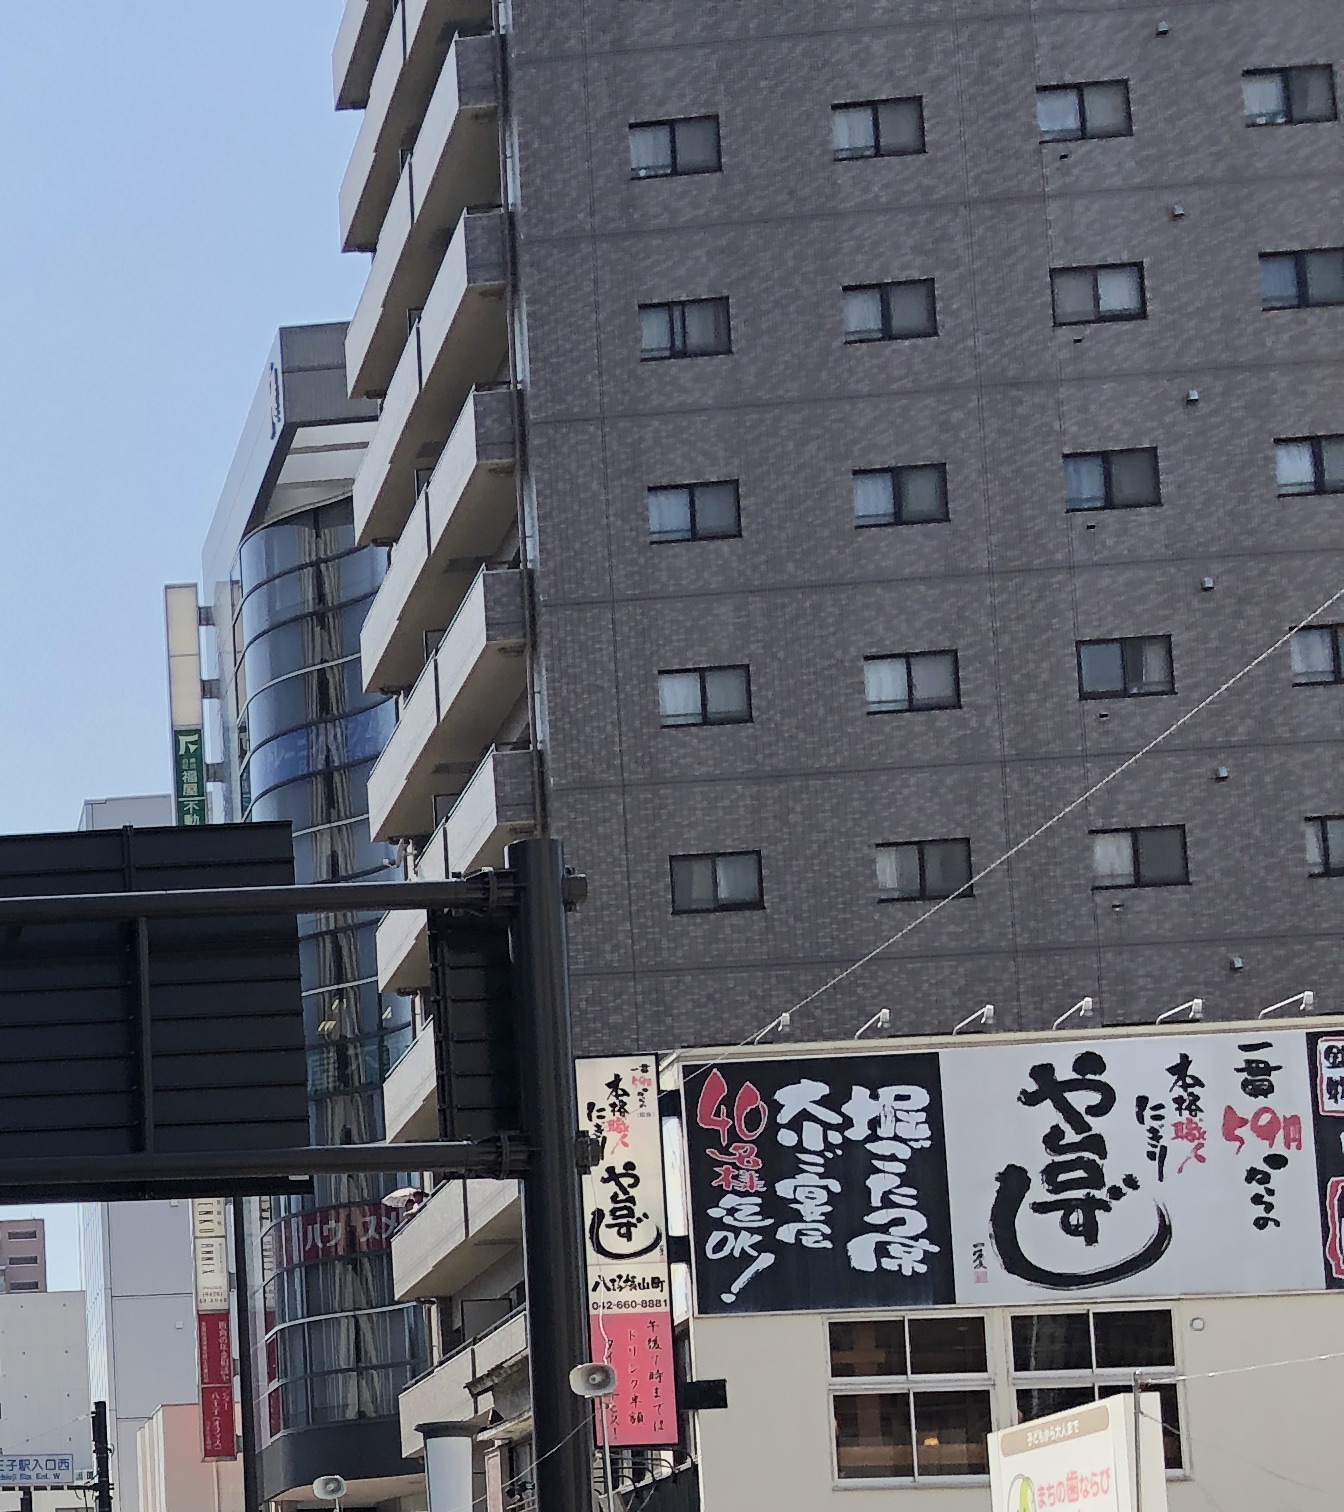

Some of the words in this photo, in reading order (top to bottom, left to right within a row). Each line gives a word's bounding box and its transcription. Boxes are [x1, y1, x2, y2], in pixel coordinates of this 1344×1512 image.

[1037, 1467, 1111, 1508] まちの歯ならび
